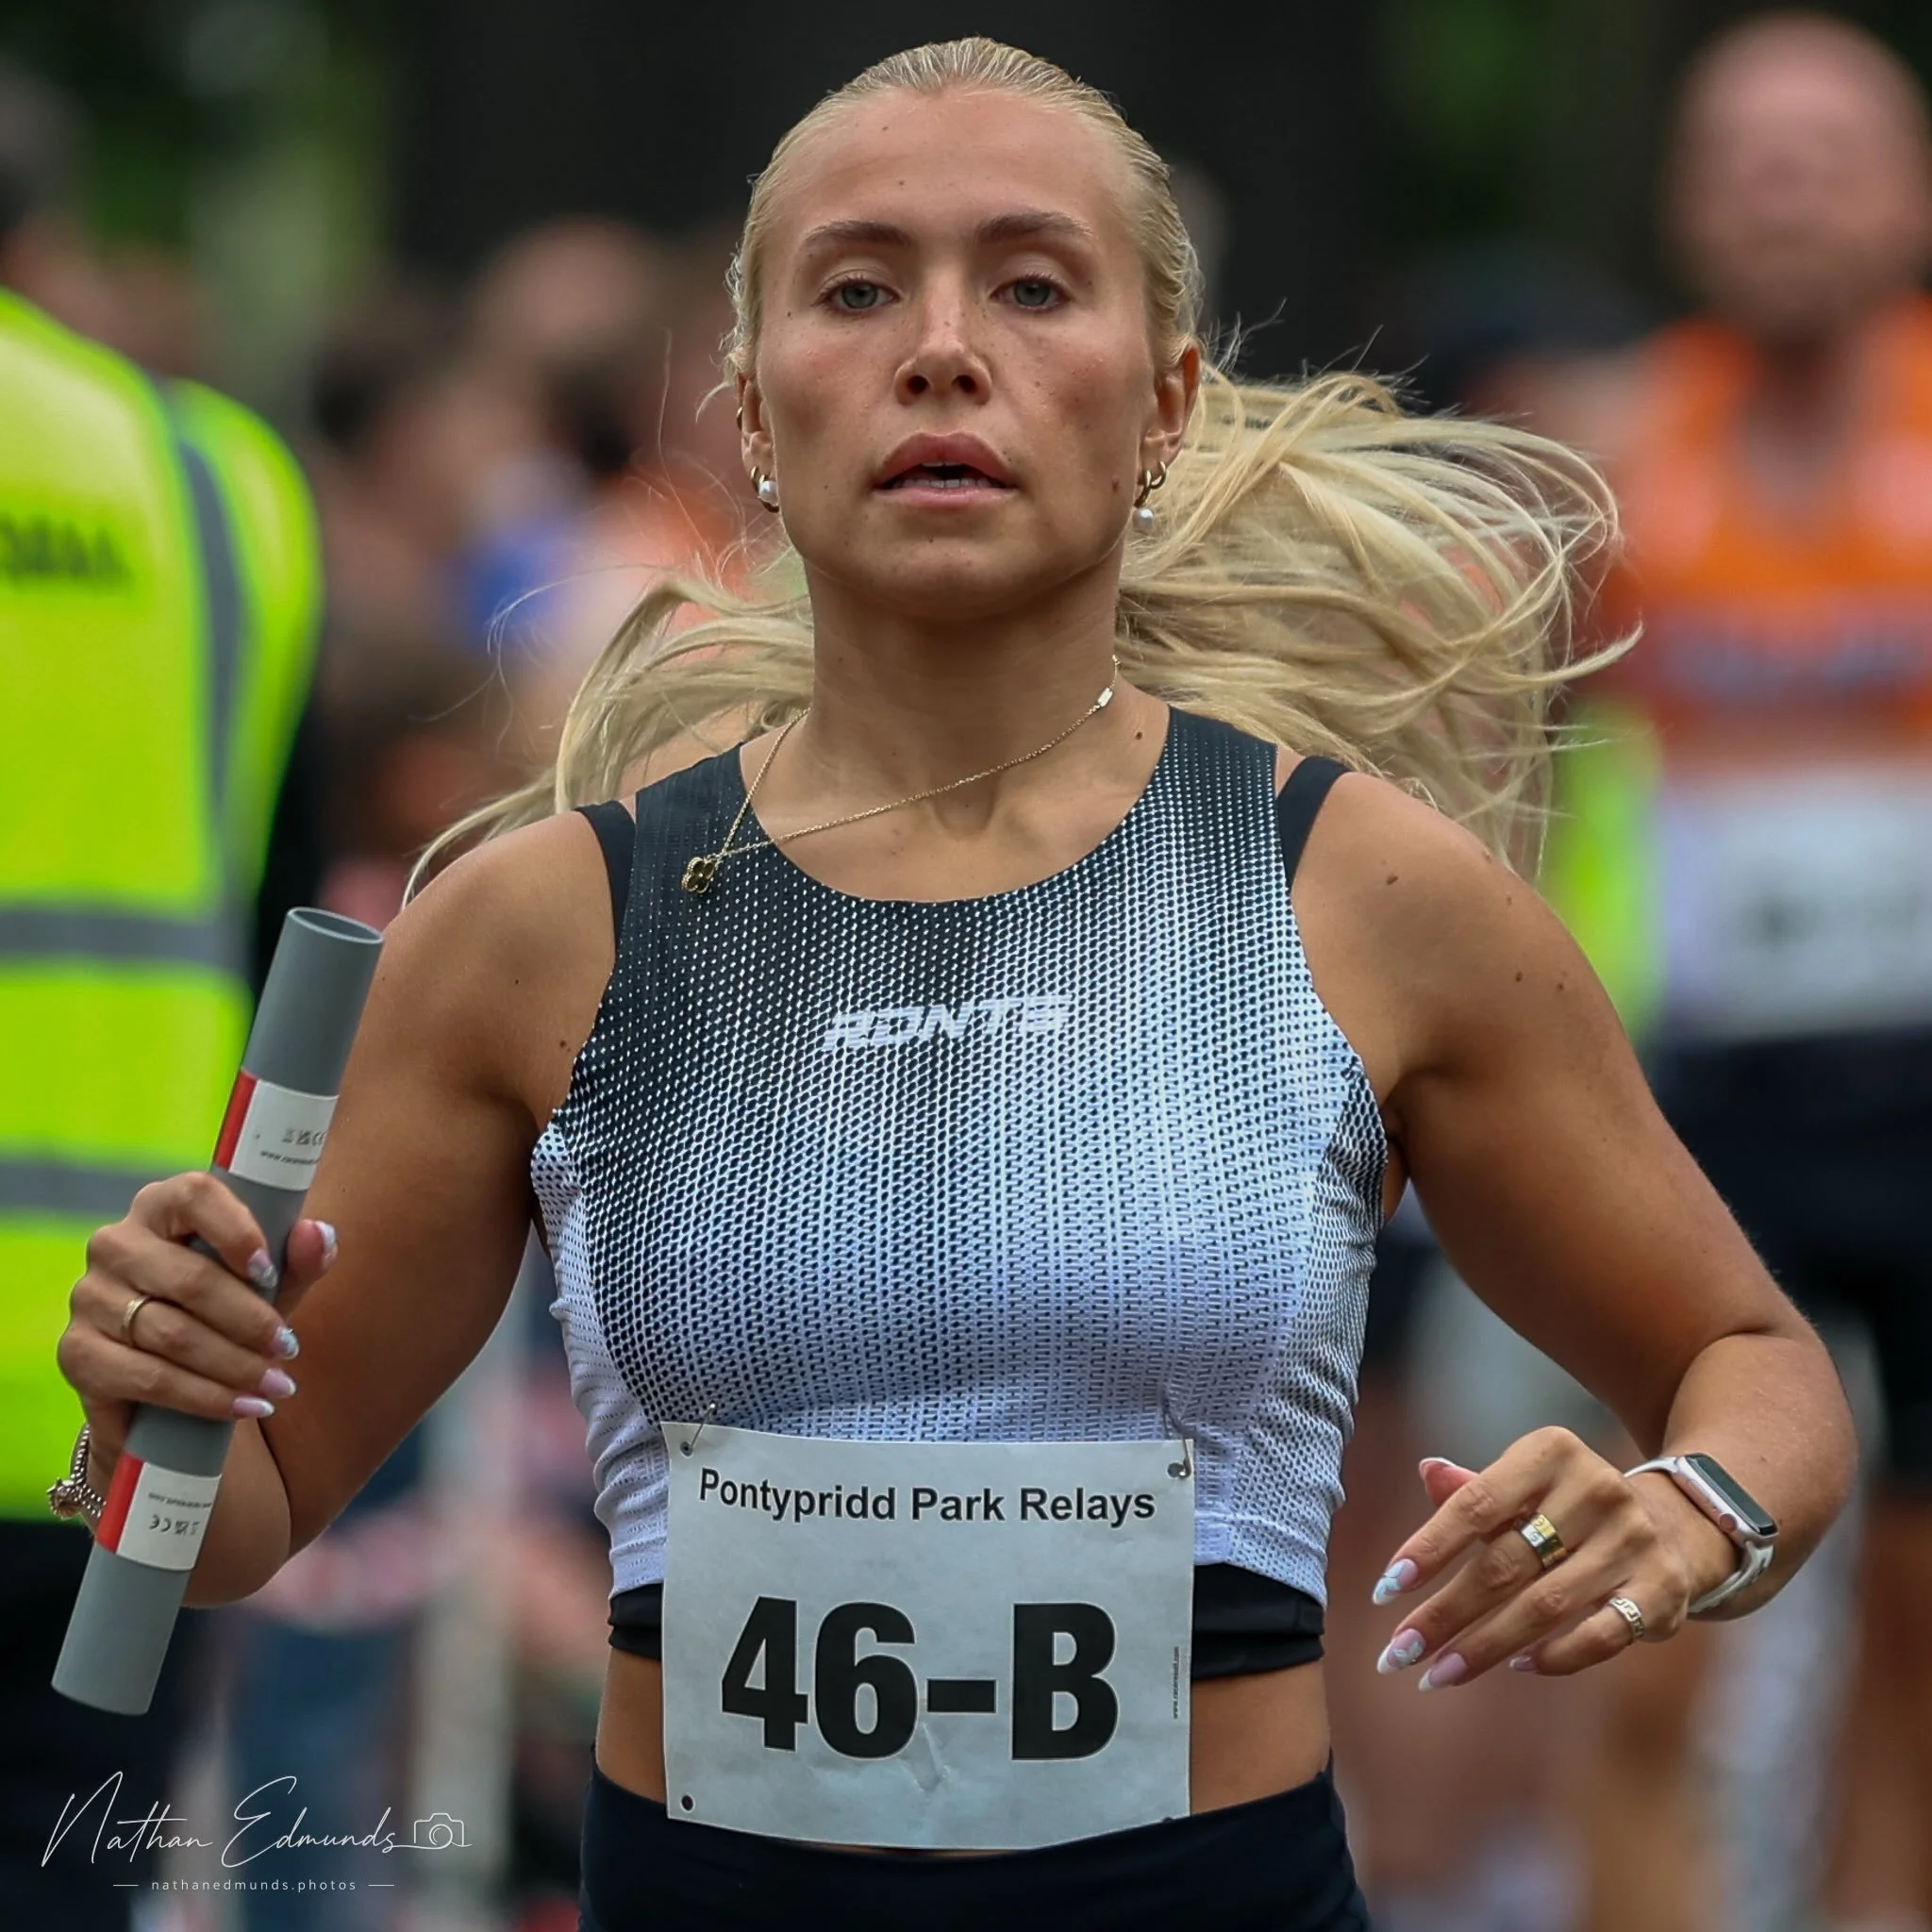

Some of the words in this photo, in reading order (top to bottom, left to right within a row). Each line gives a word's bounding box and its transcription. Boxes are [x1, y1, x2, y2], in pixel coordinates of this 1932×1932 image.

[700, 1467, 895, 1524] Pontypridd
[912, 1487, 1005, 1521] Park
[1020, 1487, 1156, 1529] Relays
[721, 1594, 1119, 1761] 46-B
